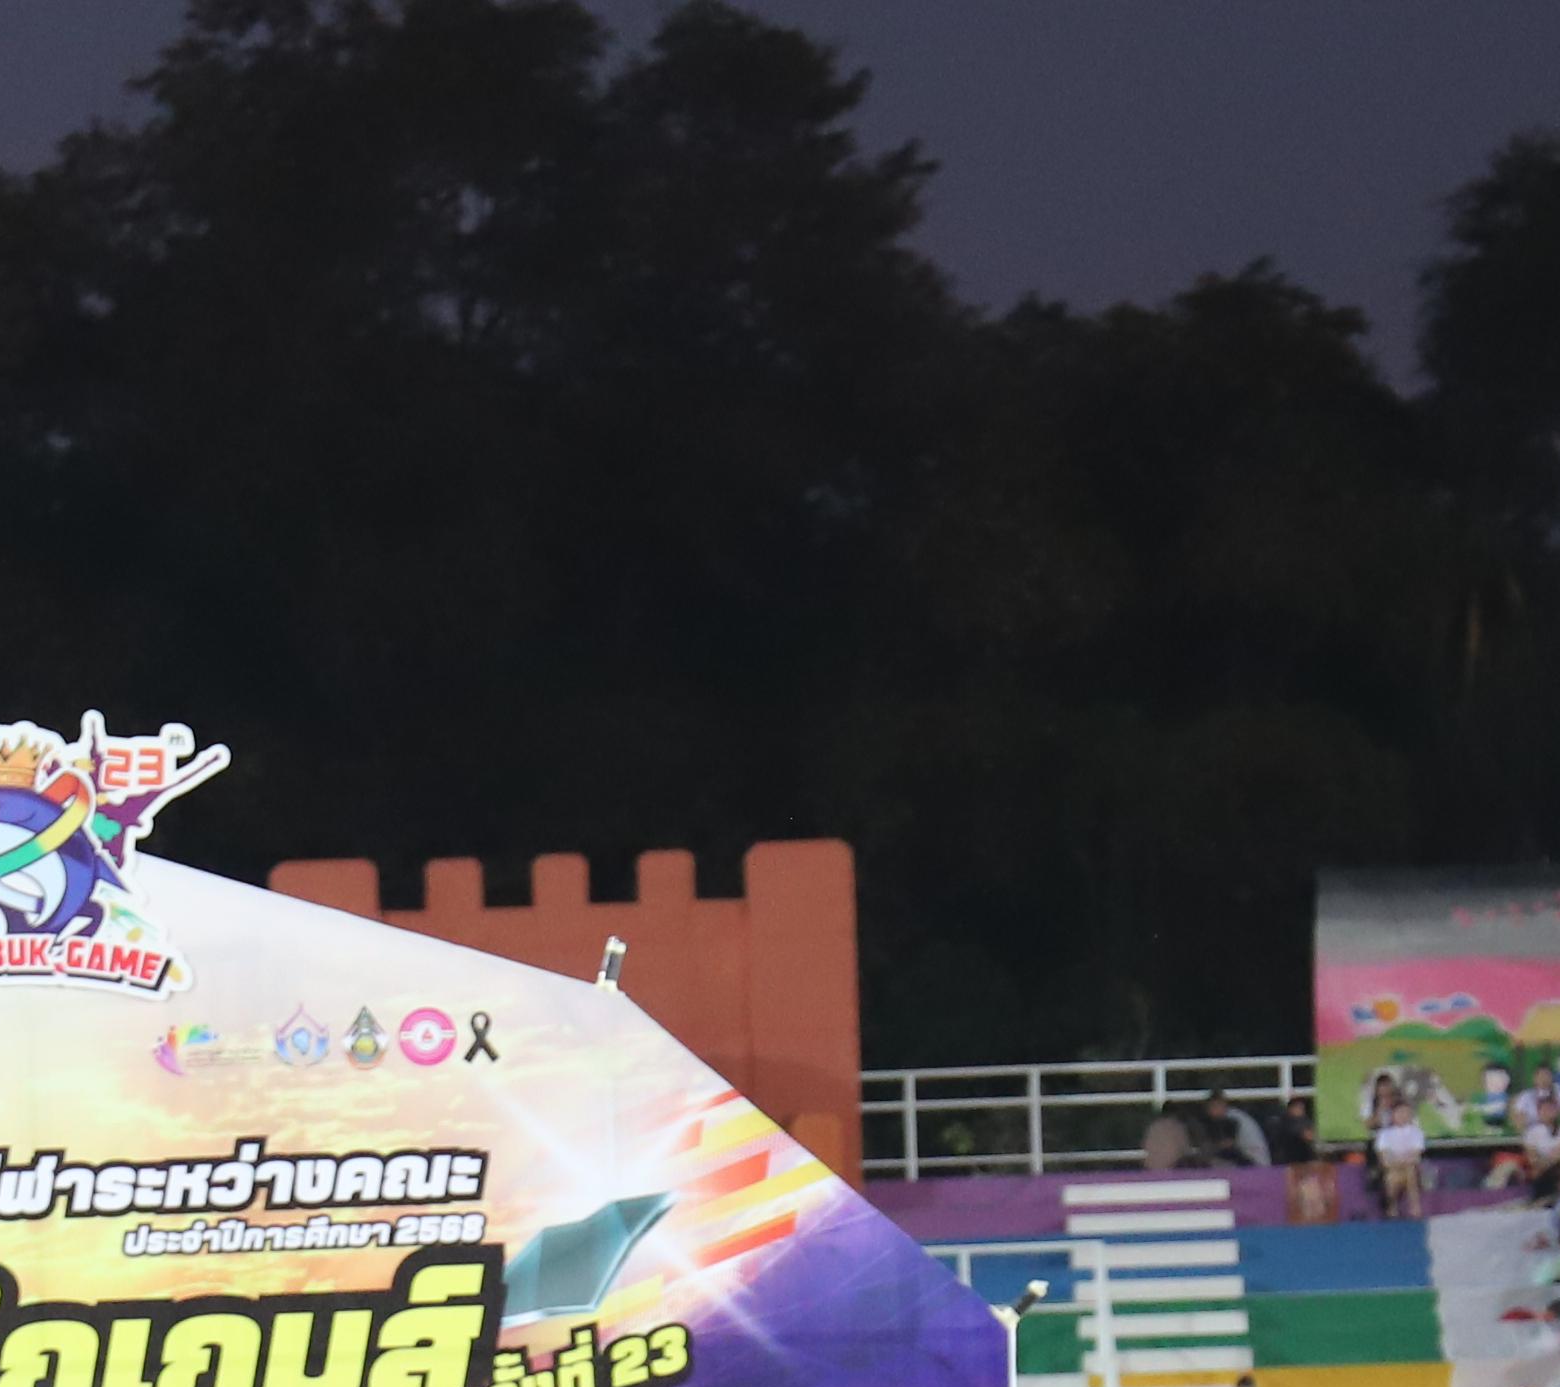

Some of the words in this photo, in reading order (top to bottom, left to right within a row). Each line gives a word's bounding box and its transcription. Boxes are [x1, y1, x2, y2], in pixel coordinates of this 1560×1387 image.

[102, 747, 164, 787] 23
[67, 939, 161, 980] GAME
[124, 1215, 390, 1256] ประจำปีการศึกษา
